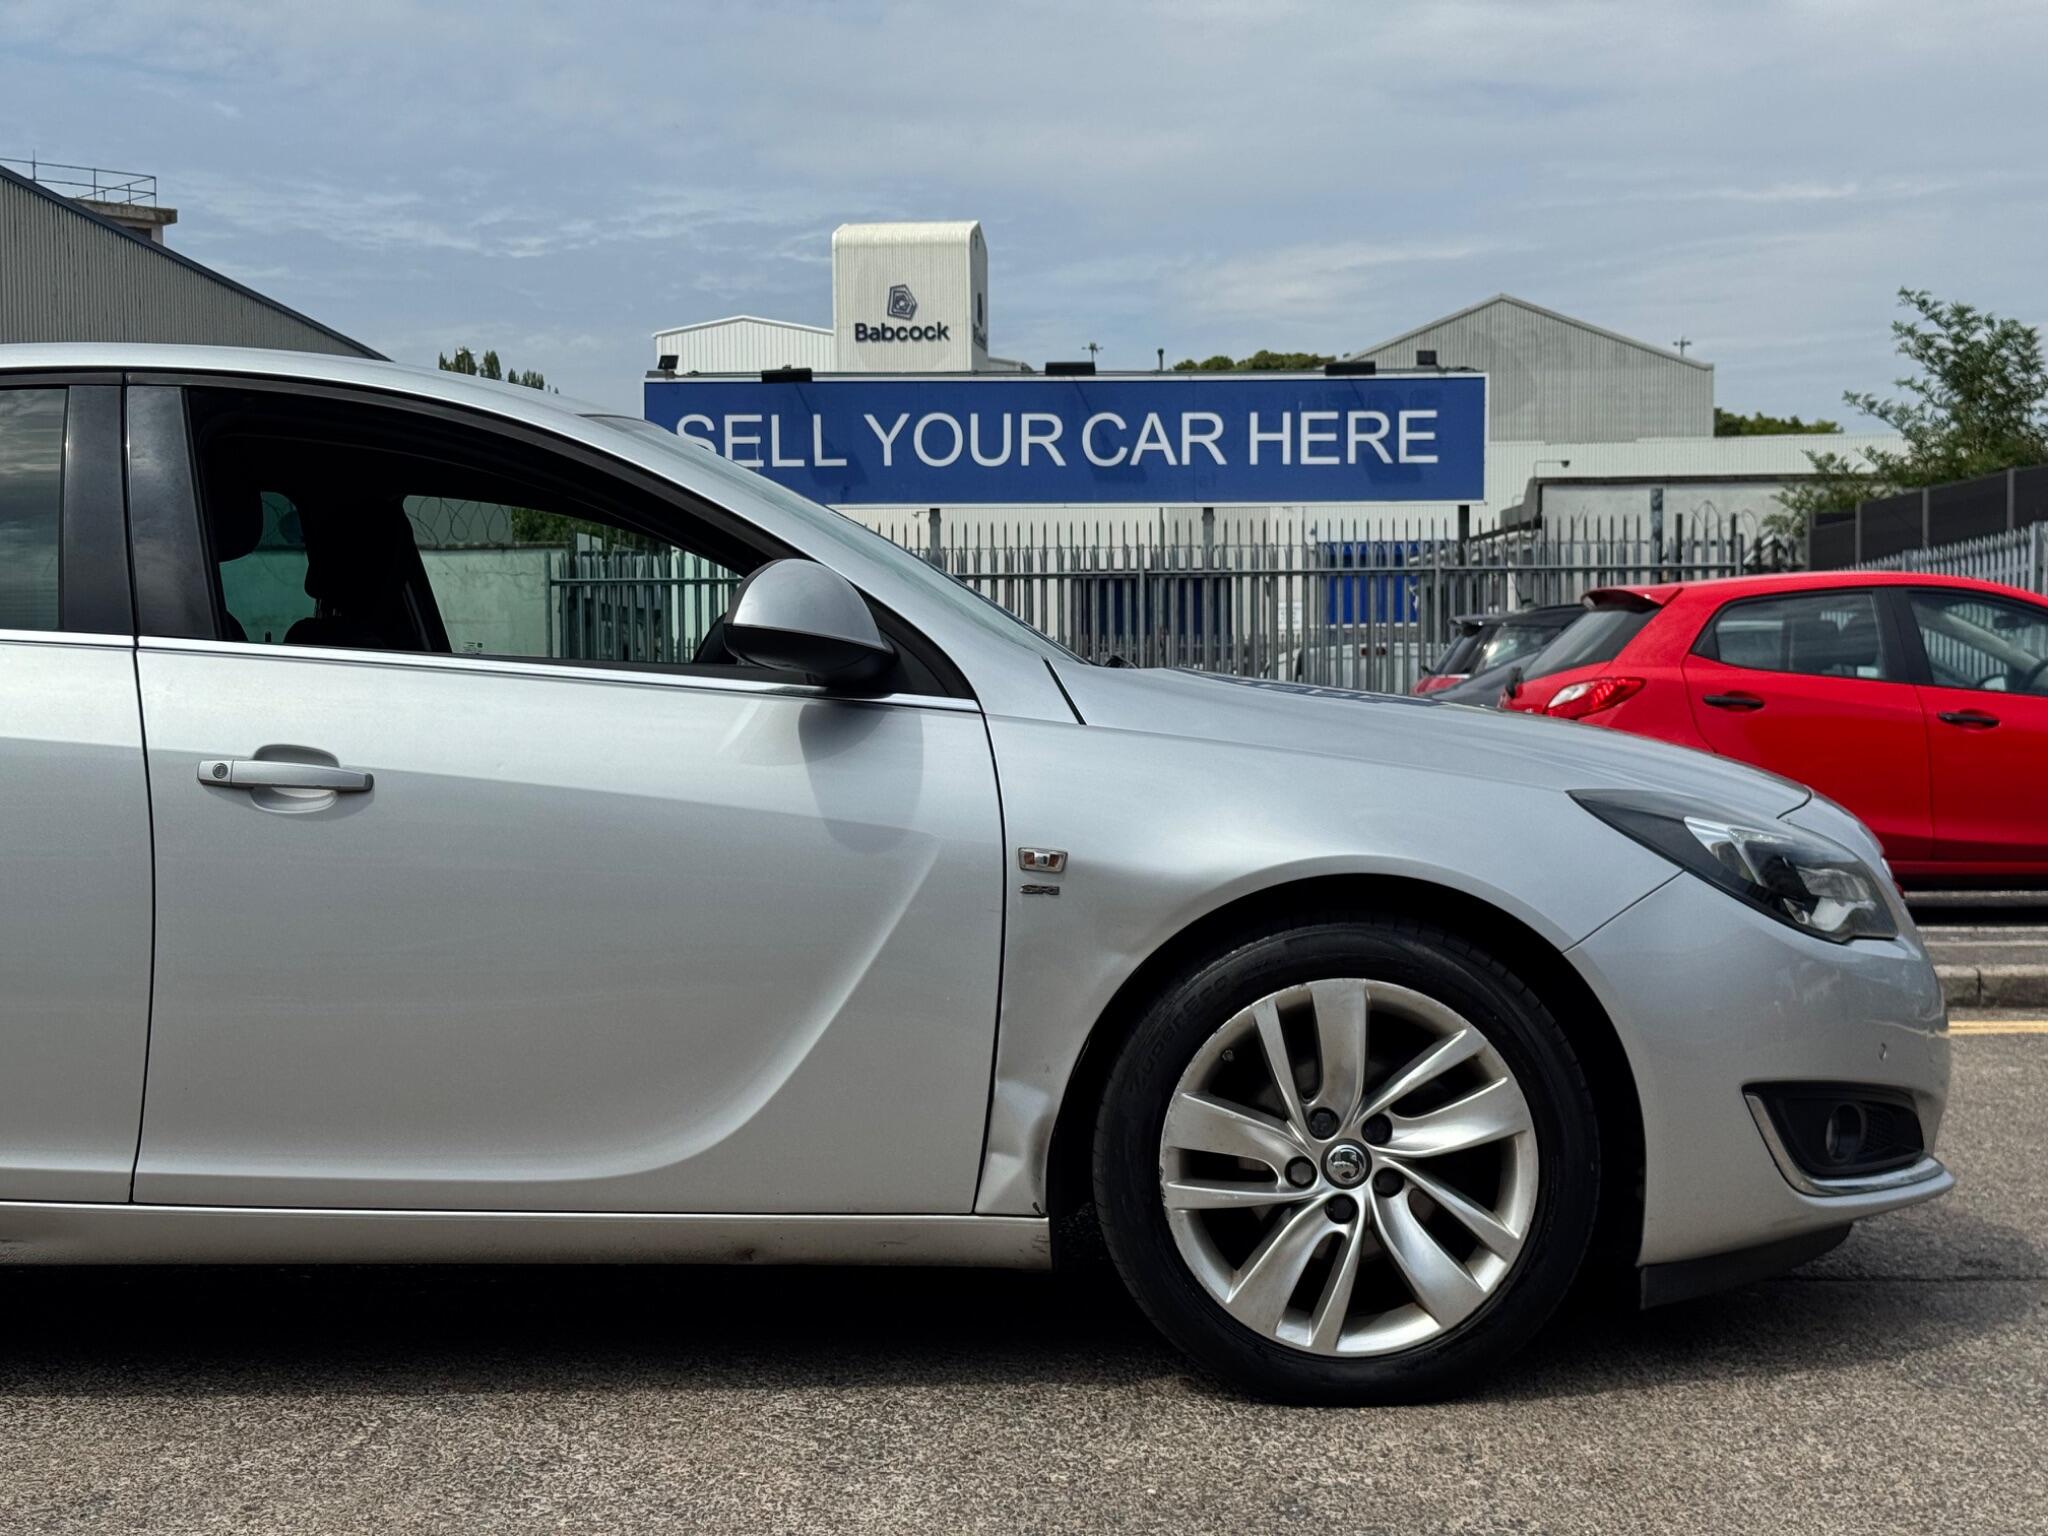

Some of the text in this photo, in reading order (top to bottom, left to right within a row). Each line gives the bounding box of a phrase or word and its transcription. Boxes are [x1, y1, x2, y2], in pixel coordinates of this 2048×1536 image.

[854, 322, 950, 342] Babcock
[676, 410, 1439, 467] SELL YOUR CAR HERE
